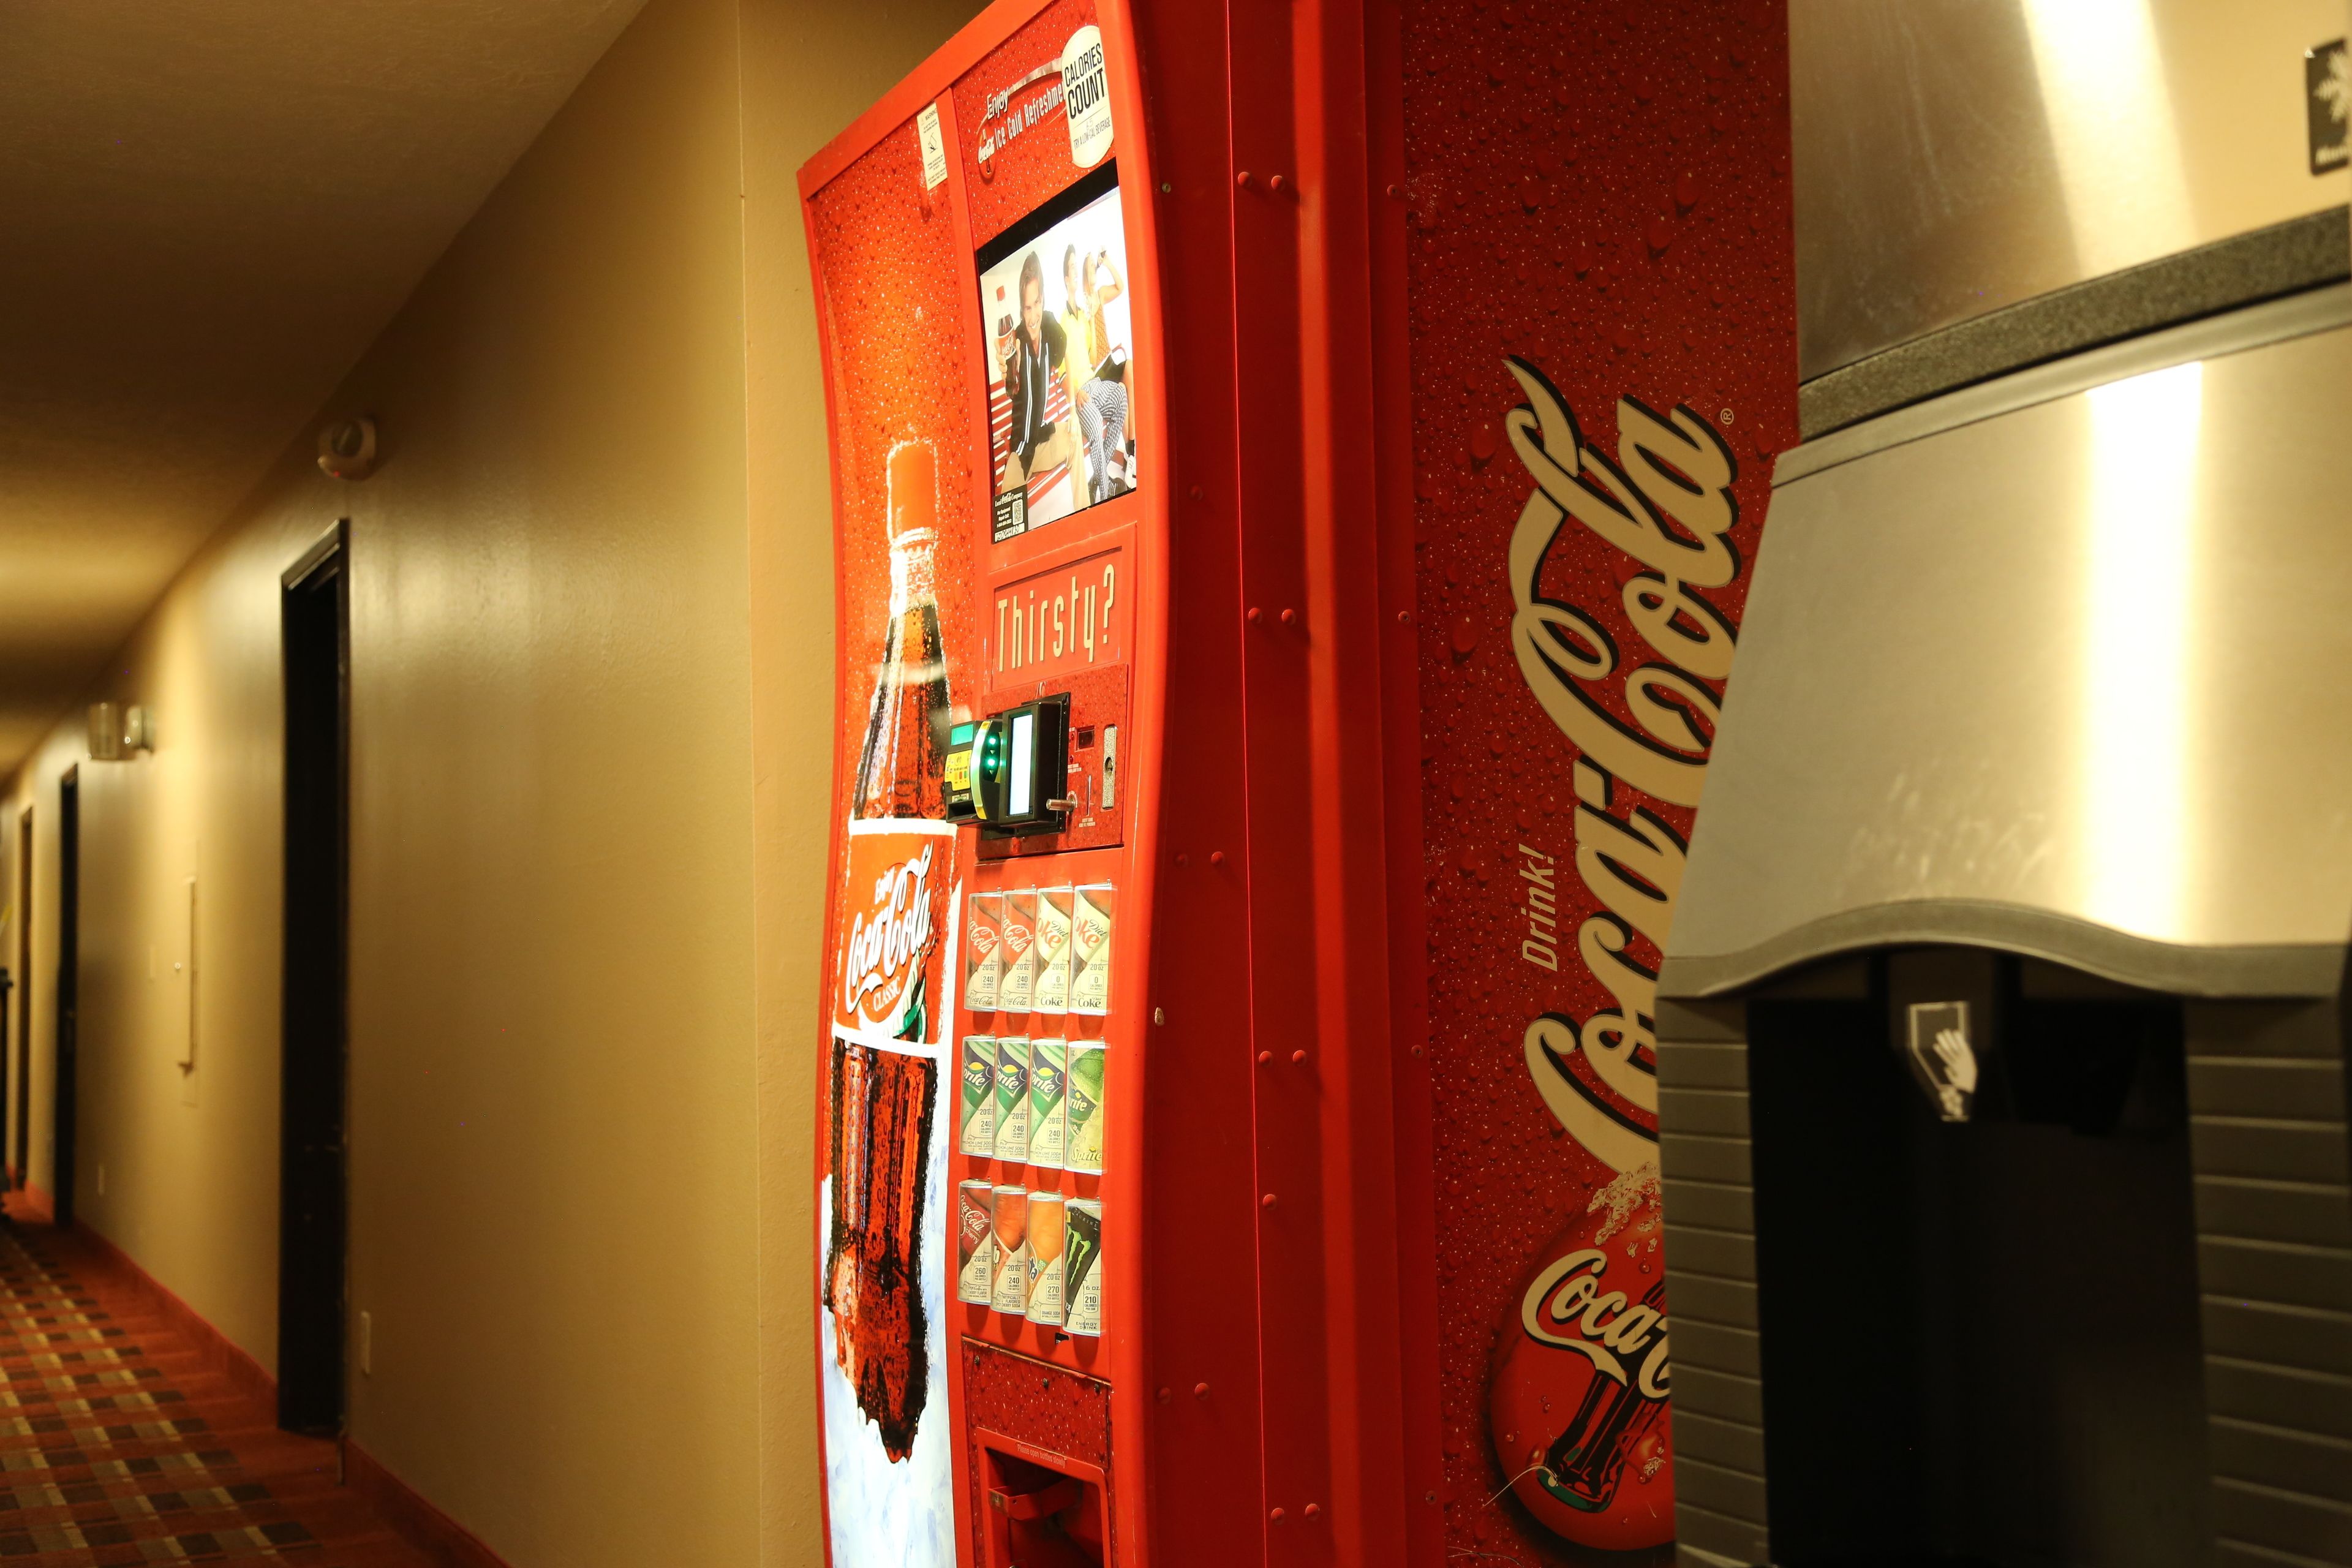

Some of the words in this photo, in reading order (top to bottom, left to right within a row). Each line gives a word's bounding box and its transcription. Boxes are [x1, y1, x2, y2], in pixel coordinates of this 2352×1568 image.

[1065, 43, 1102, 87] CALORIES
[986, 86, 1009, 120] Enjoy
[1068, 67, 1105, 119] COUNT
[994, 126, 1006, 150] Ice
[1007, 108, 1023, 140] Cold
[1023, 81, 1066, 127] Refreshme
[1095, 116, 1110, 135] BEVERAGE
[998, 564, 1115, 672] Thirsty?
[874, 865, 896, 905] Enjoy
[1518, 843, 1558, 972] Drink!
[1037, 918, 1061, 949] oke
[1051, 920, 1069, 937] Diet
[1089, 919, 1107, 937] Diet
[873, 975, 901, 1012] CLASSIC
[1041, 996, 1063, 1006] Coke
[1078, 997, 1101, 1008] Coke
[963, 1064, 986, 1086] prite
[997, 1066, 1019, 1089] prite
[1071, 1147, 1102, 1163] Sprite
[965, 1228, 979, 1245] cherry
[1017, 1444, 1030, 1455] Please
[1030, 1449, 1039, 1458] open
[1039, 1450, 1053, 1463] bottles
[1053, 1455, 1065, 1469] slowly
